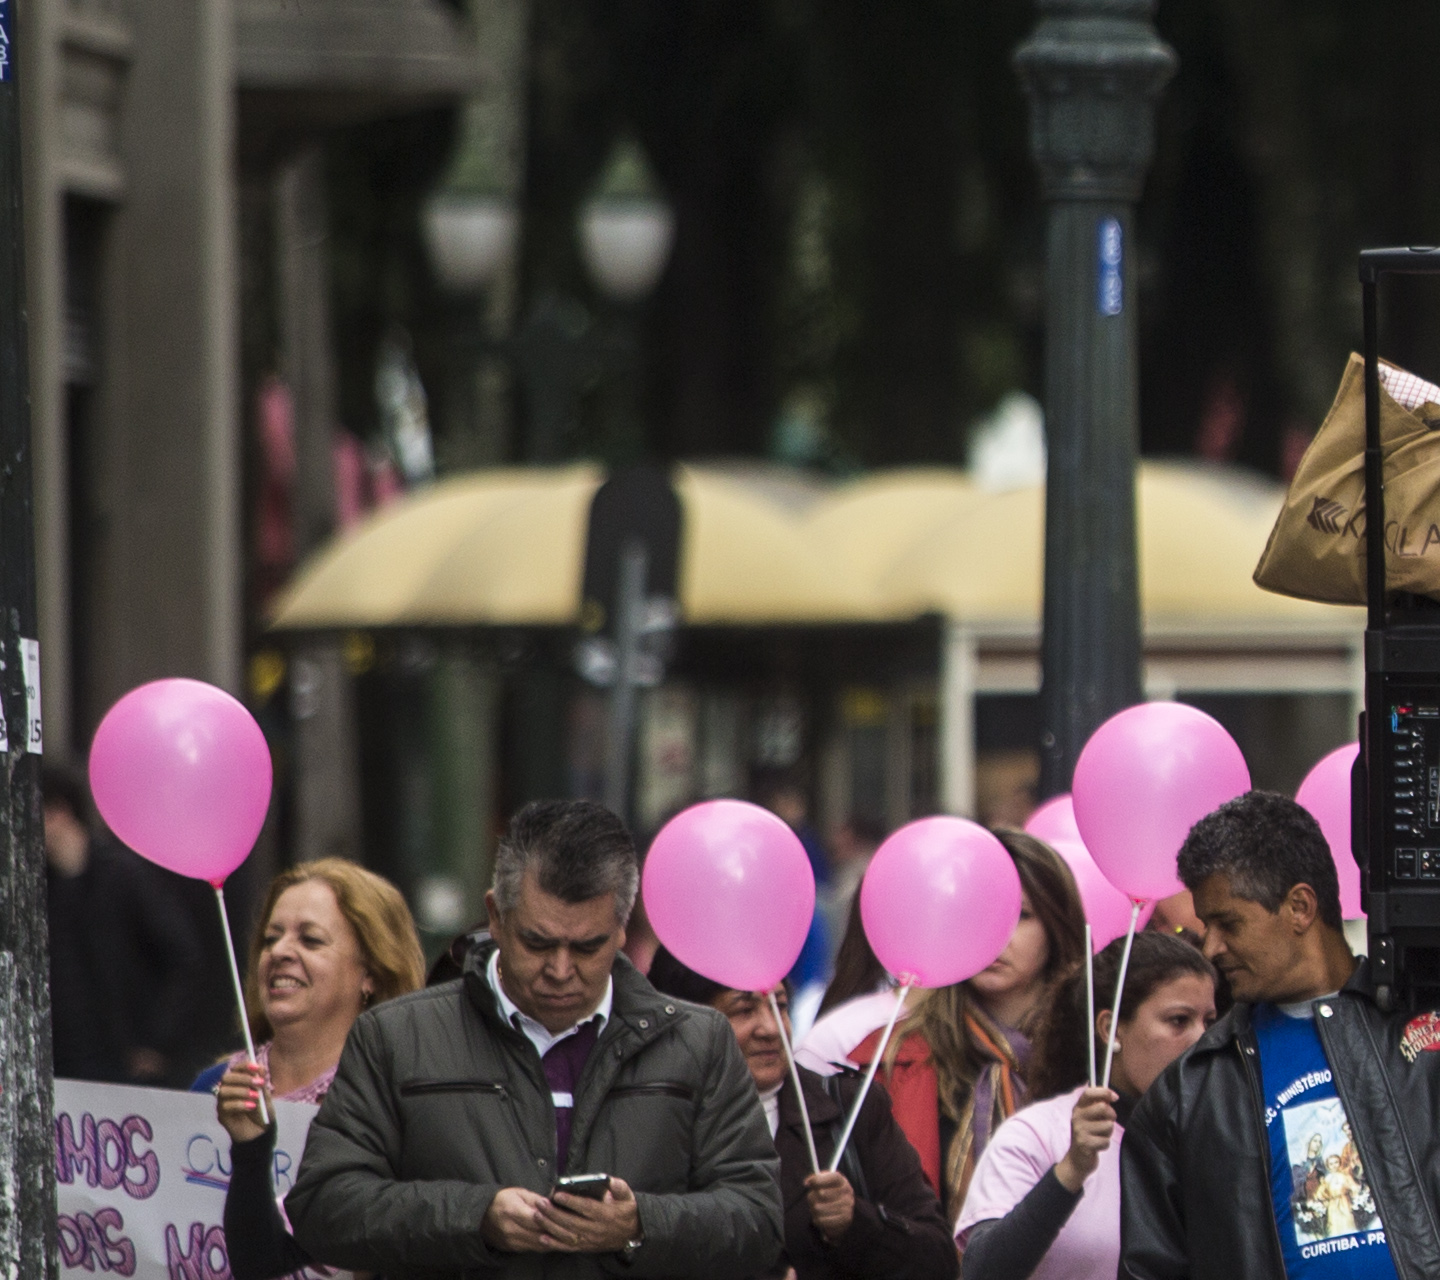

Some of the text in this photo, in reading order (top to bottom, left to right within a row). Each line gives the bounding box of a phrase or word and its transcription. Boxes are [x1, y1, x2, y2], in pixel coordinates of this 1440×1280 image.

[1277, 1069, 1333, 1107] MINISTÉRIO
[1301, 1235, 1359, 1260] CURITIBA
[1367, 1231, 1386, 1246] PR
